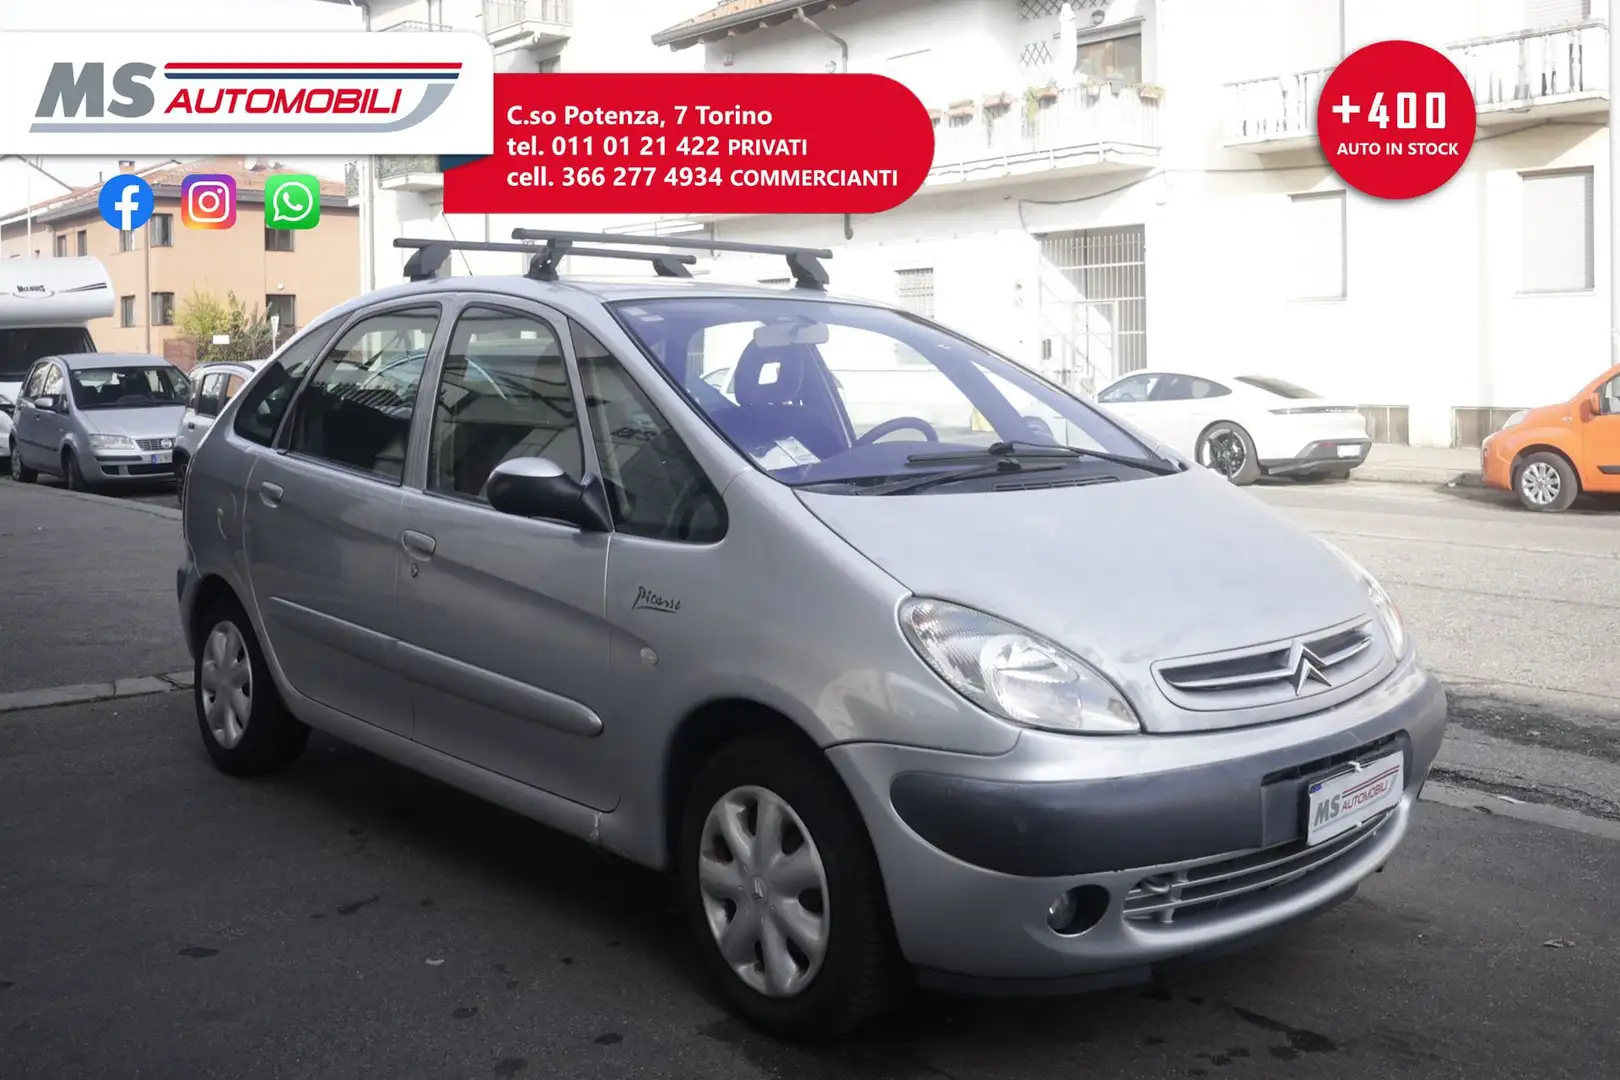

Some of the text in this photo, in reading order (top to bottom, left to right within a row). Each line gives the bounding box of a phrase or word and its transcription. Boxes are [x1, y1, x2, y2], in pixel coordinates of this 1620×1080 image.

[631, 585, 681, 611] Picasso
[1313, 779, 1389, 827] MS AUTOMOBILI
